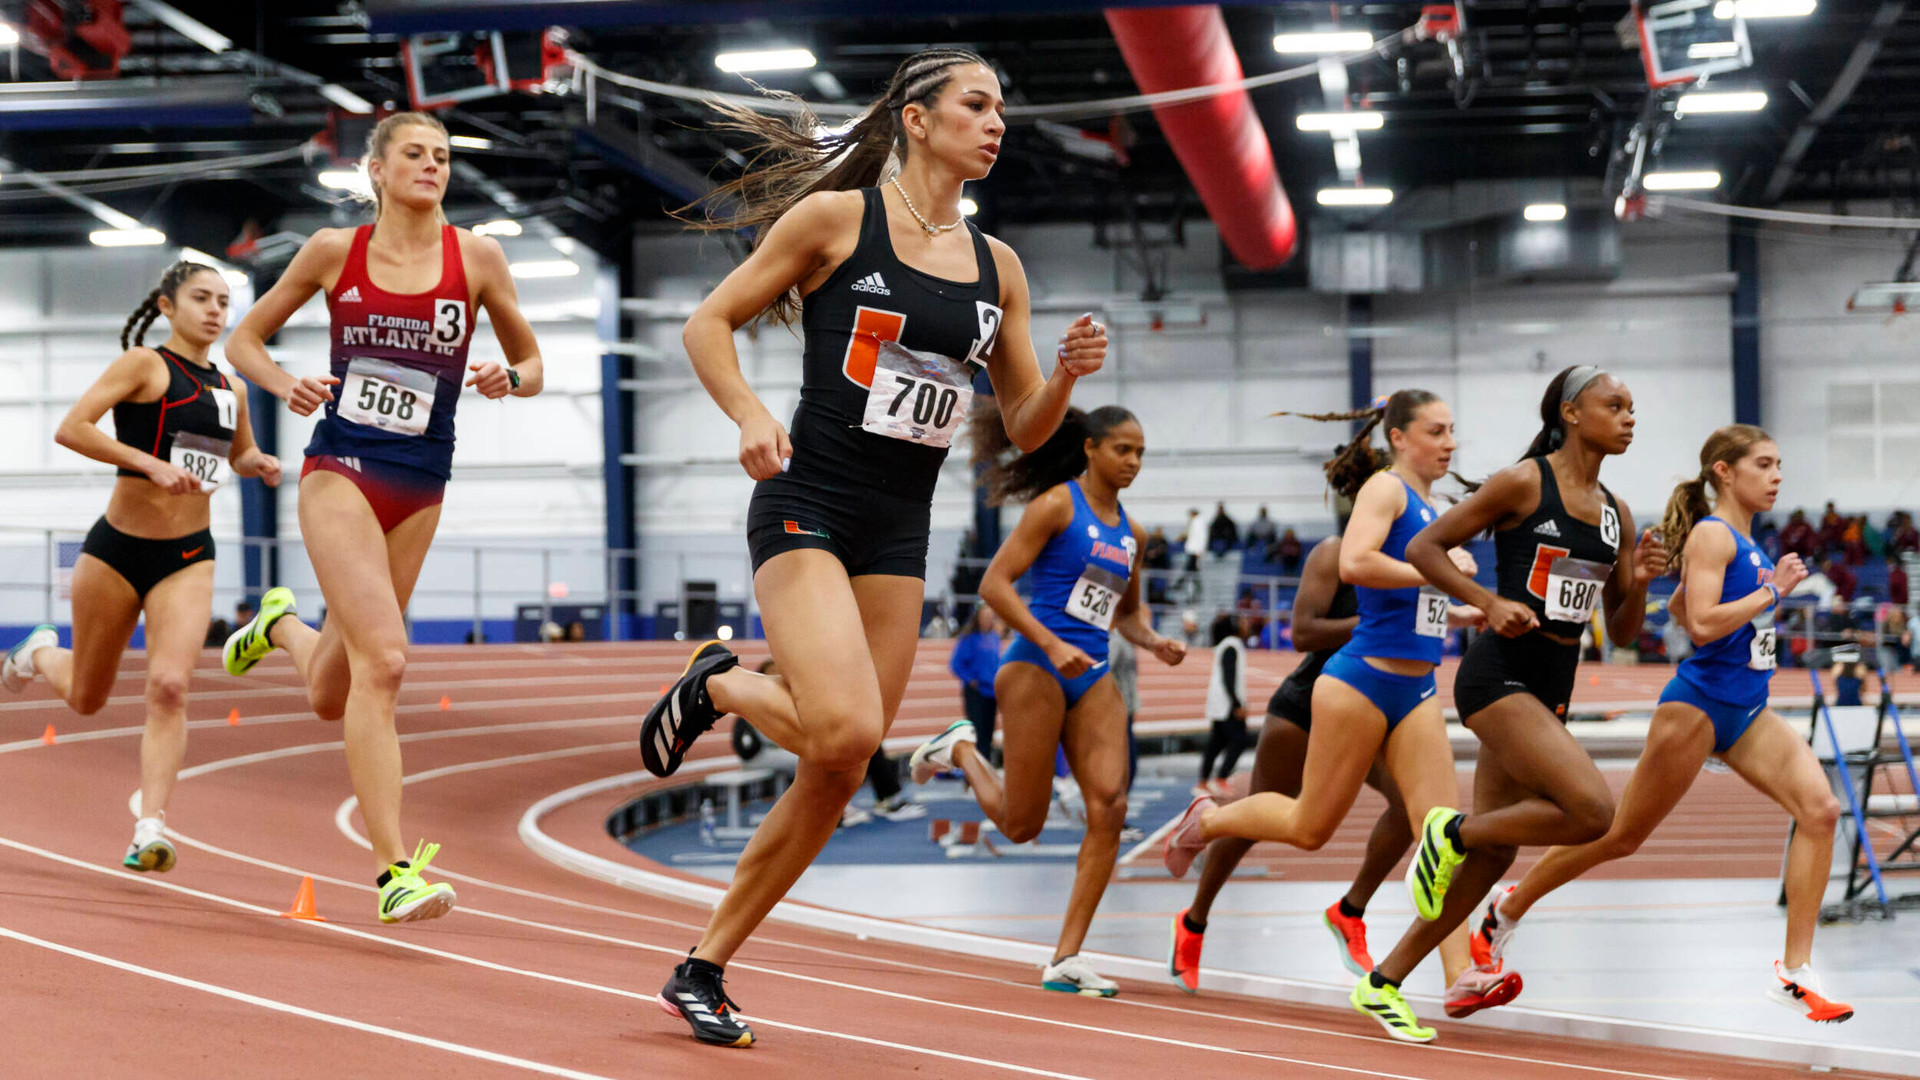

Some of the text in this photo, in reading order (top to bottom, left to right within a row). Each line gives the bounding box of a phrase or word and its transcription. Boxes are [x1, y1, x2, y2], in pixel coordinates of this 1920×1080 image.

[851, 283, 891, 296] adidas
[367, 314, 430, 333] FLORIDA
[437, 303, 460, 343] 3
[976, 308, 999, 363] 2
[357, 378, 417, 420] 568
[887, 376, 958, 429] 700
[183, 453, 219, 484] 882
[1604, 509, 1617, 543] 8
[1081, 584, 1112, 616] 526
[1559, 580, 1597, 610] 680
